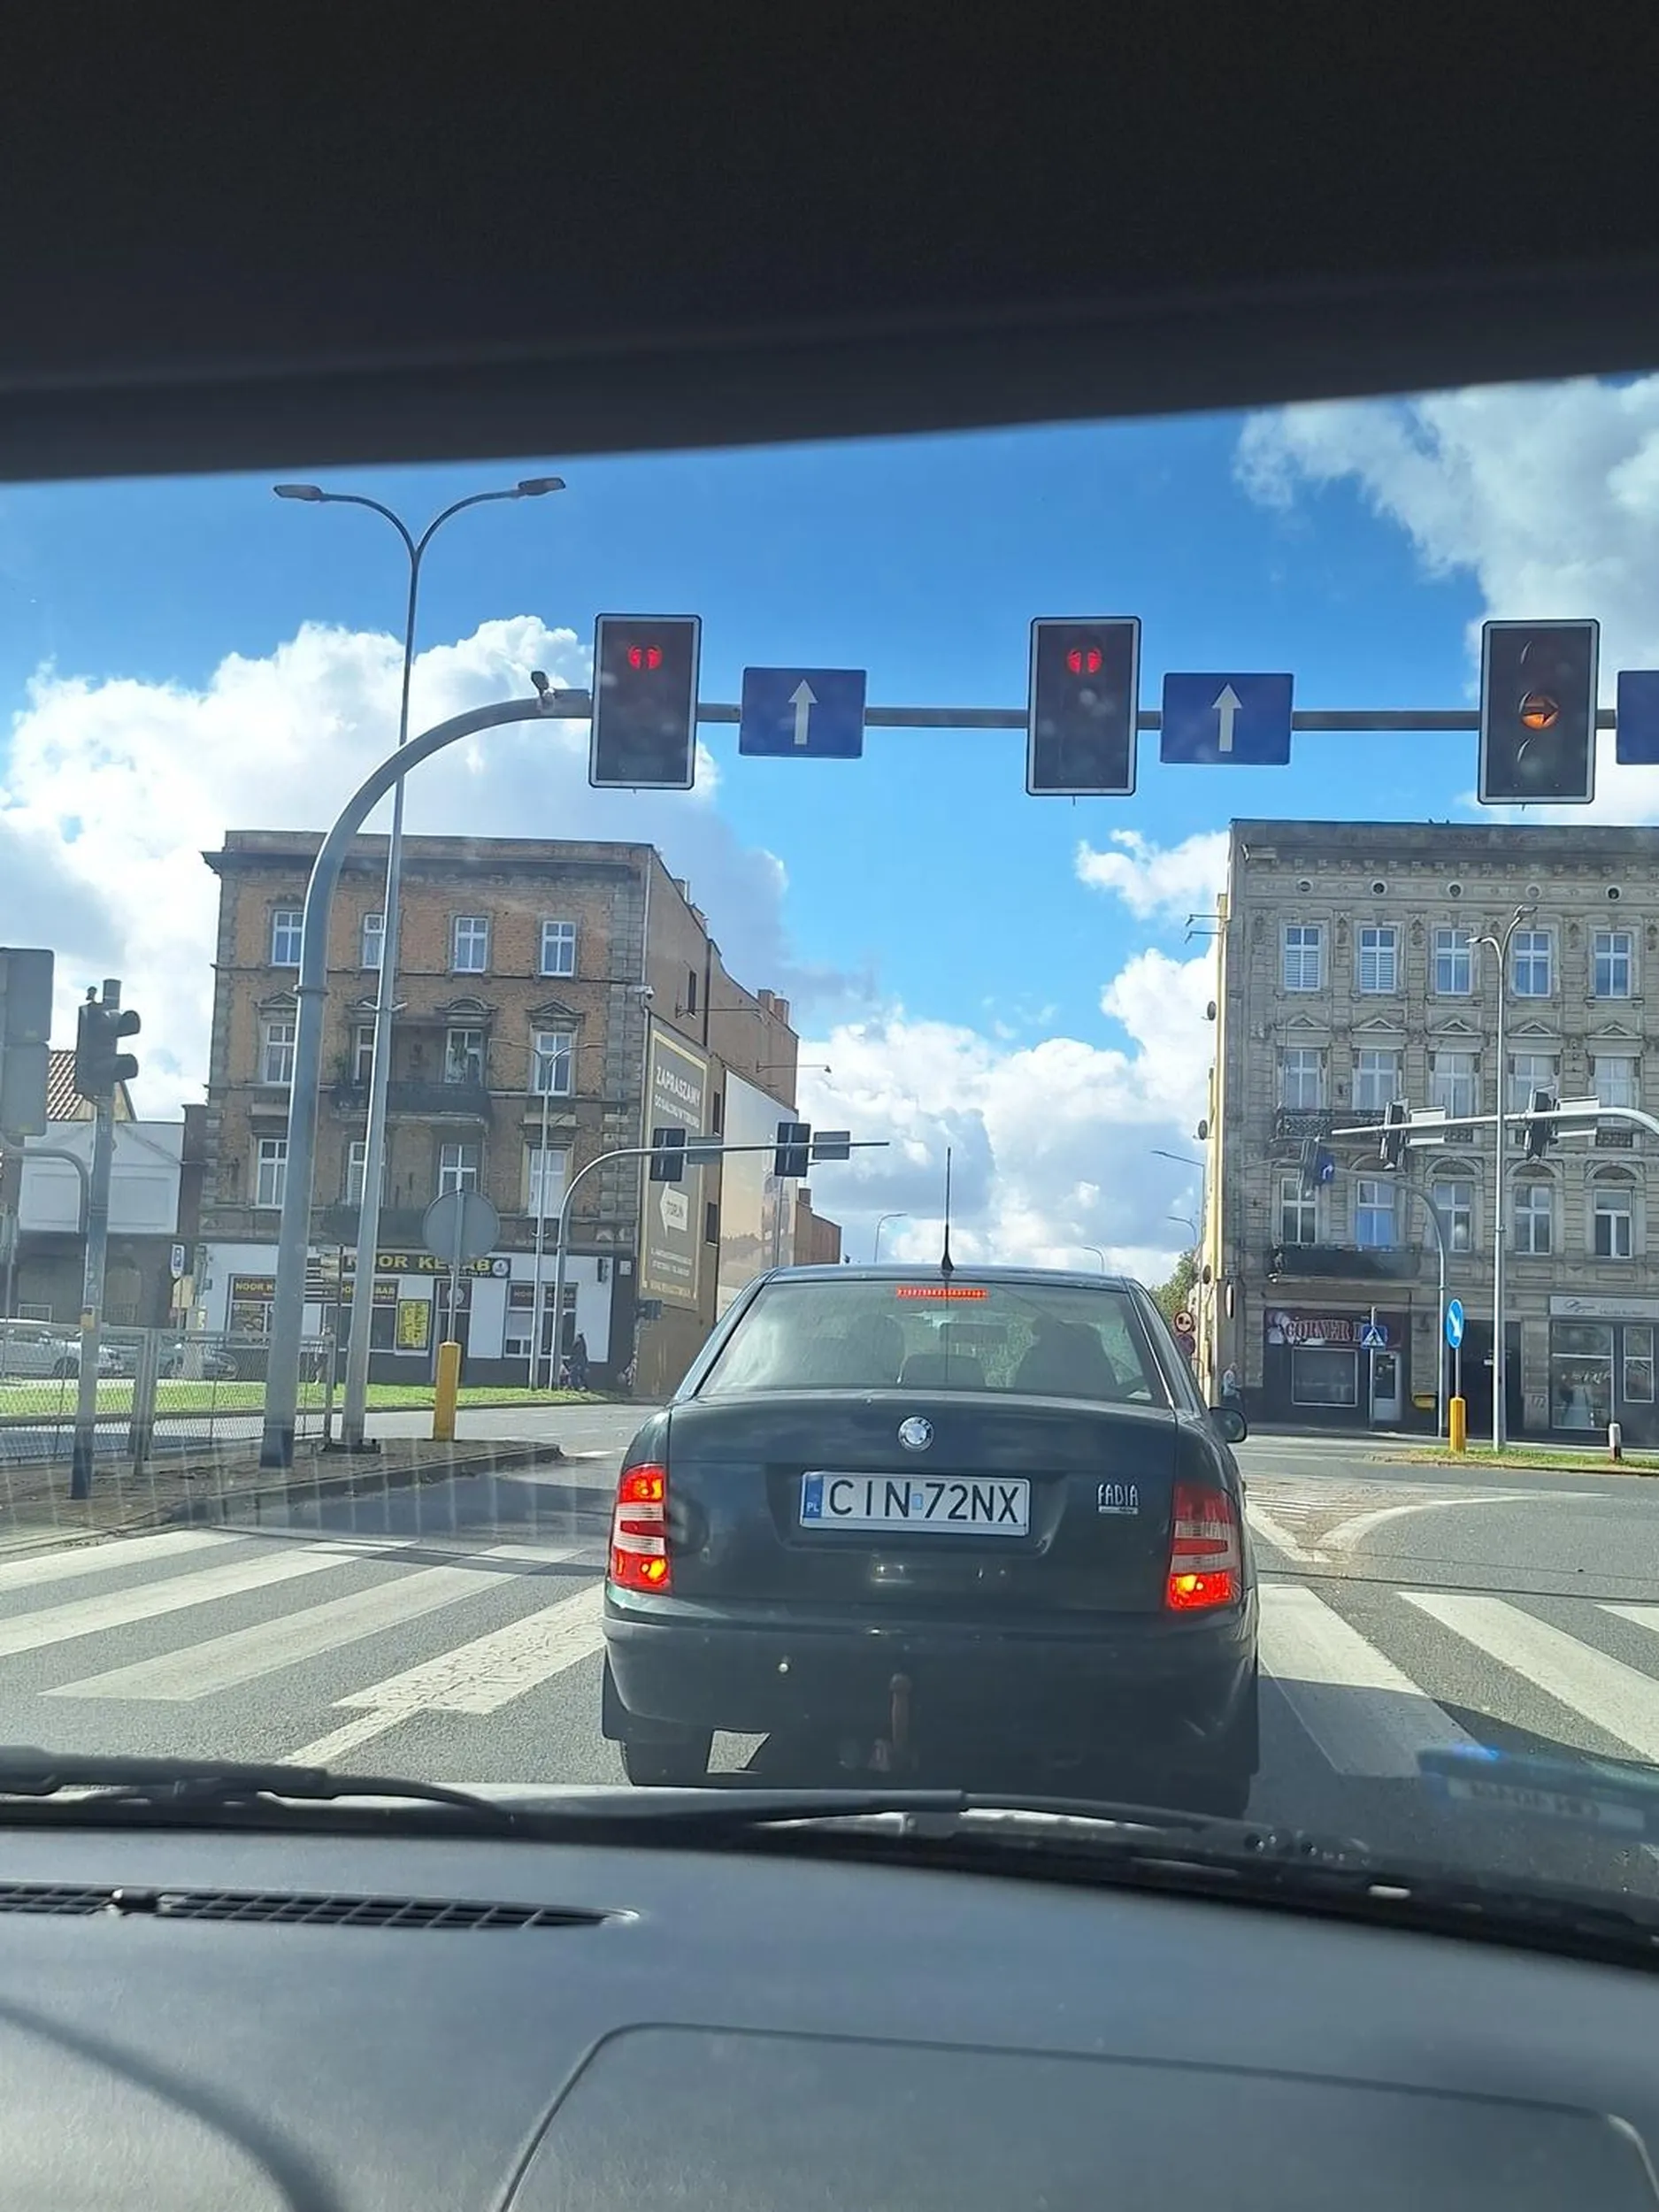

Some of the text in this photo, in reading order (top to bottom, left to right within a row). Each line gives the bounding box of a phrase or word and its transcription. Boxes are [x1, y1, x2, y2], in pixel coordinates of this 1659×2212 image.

[348, 1255, 409, 1269] NOR
[235, 1282, 264, 1292] NOOR
[806, 1501, 820, 1513] PL
[829, 1480, 1020, 1524] CIN 72NX
